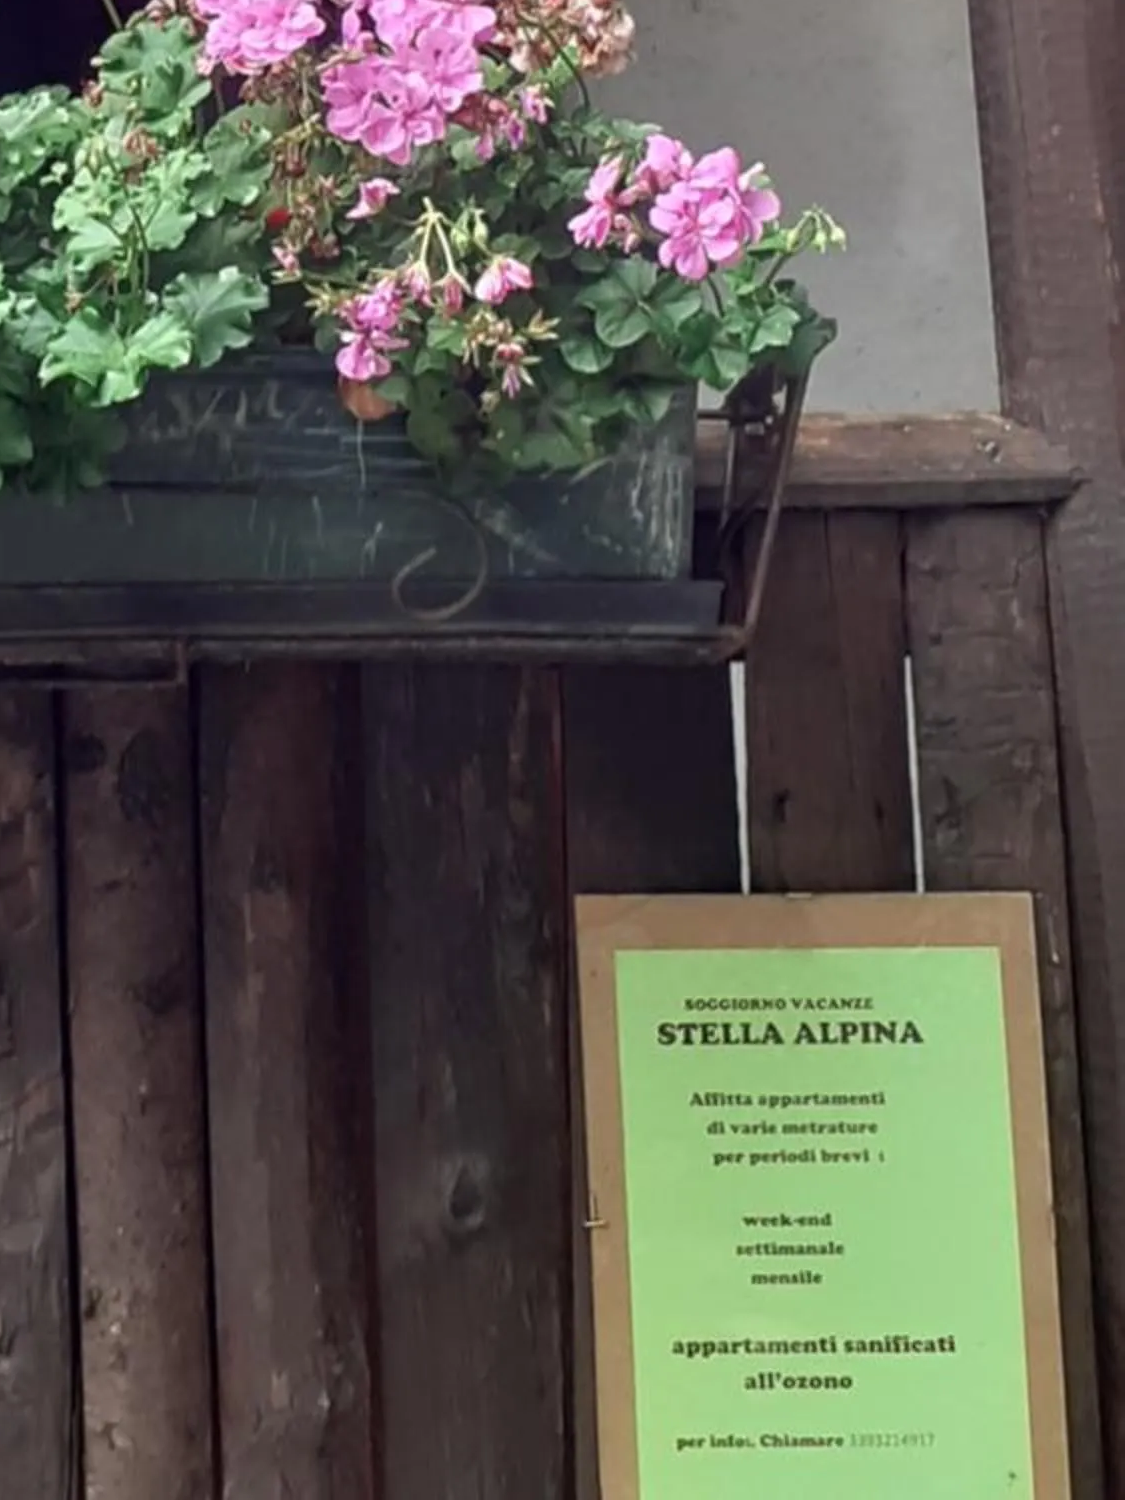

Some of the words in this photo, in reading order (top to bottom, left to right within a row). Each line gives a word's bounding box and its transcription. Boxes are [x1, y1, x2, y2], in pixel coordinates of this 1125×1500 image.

[684, 998, 787, 1011] SOGGIORNO
[791, 997, 875, 1011] VACANZE
[656, 1021, 785, 1046] STELLA
[793, 1020, 924, 1045] ALPINA
[689, 1092, 753, 1107] Affitta
[757, 1091, 886, 1109] appartamenti
[706, 1120, 725, 1135] di
[729, 1120, 778, 1135] varie
[781, 1120, 879, 1135] metrature
[712, 1151, 745, 1167] per
[749, 1149, 816, 1166] periodi
[820, 1148, 870, 1164] brevi
[742, 1212, 832, 1228] week-end
[735, 1241, 845, 1257] settimanale
[751, 1270, 823, 1285] mensile
[671, 1337, 838, 1359] appartamenti
[843, 1335, 956, 1354] sanificati
[744, 1372, 853, 1390] all'ozono
[676, 1436, 706, 1452] per
[760, 1433, 844, 1448] Chiamare
